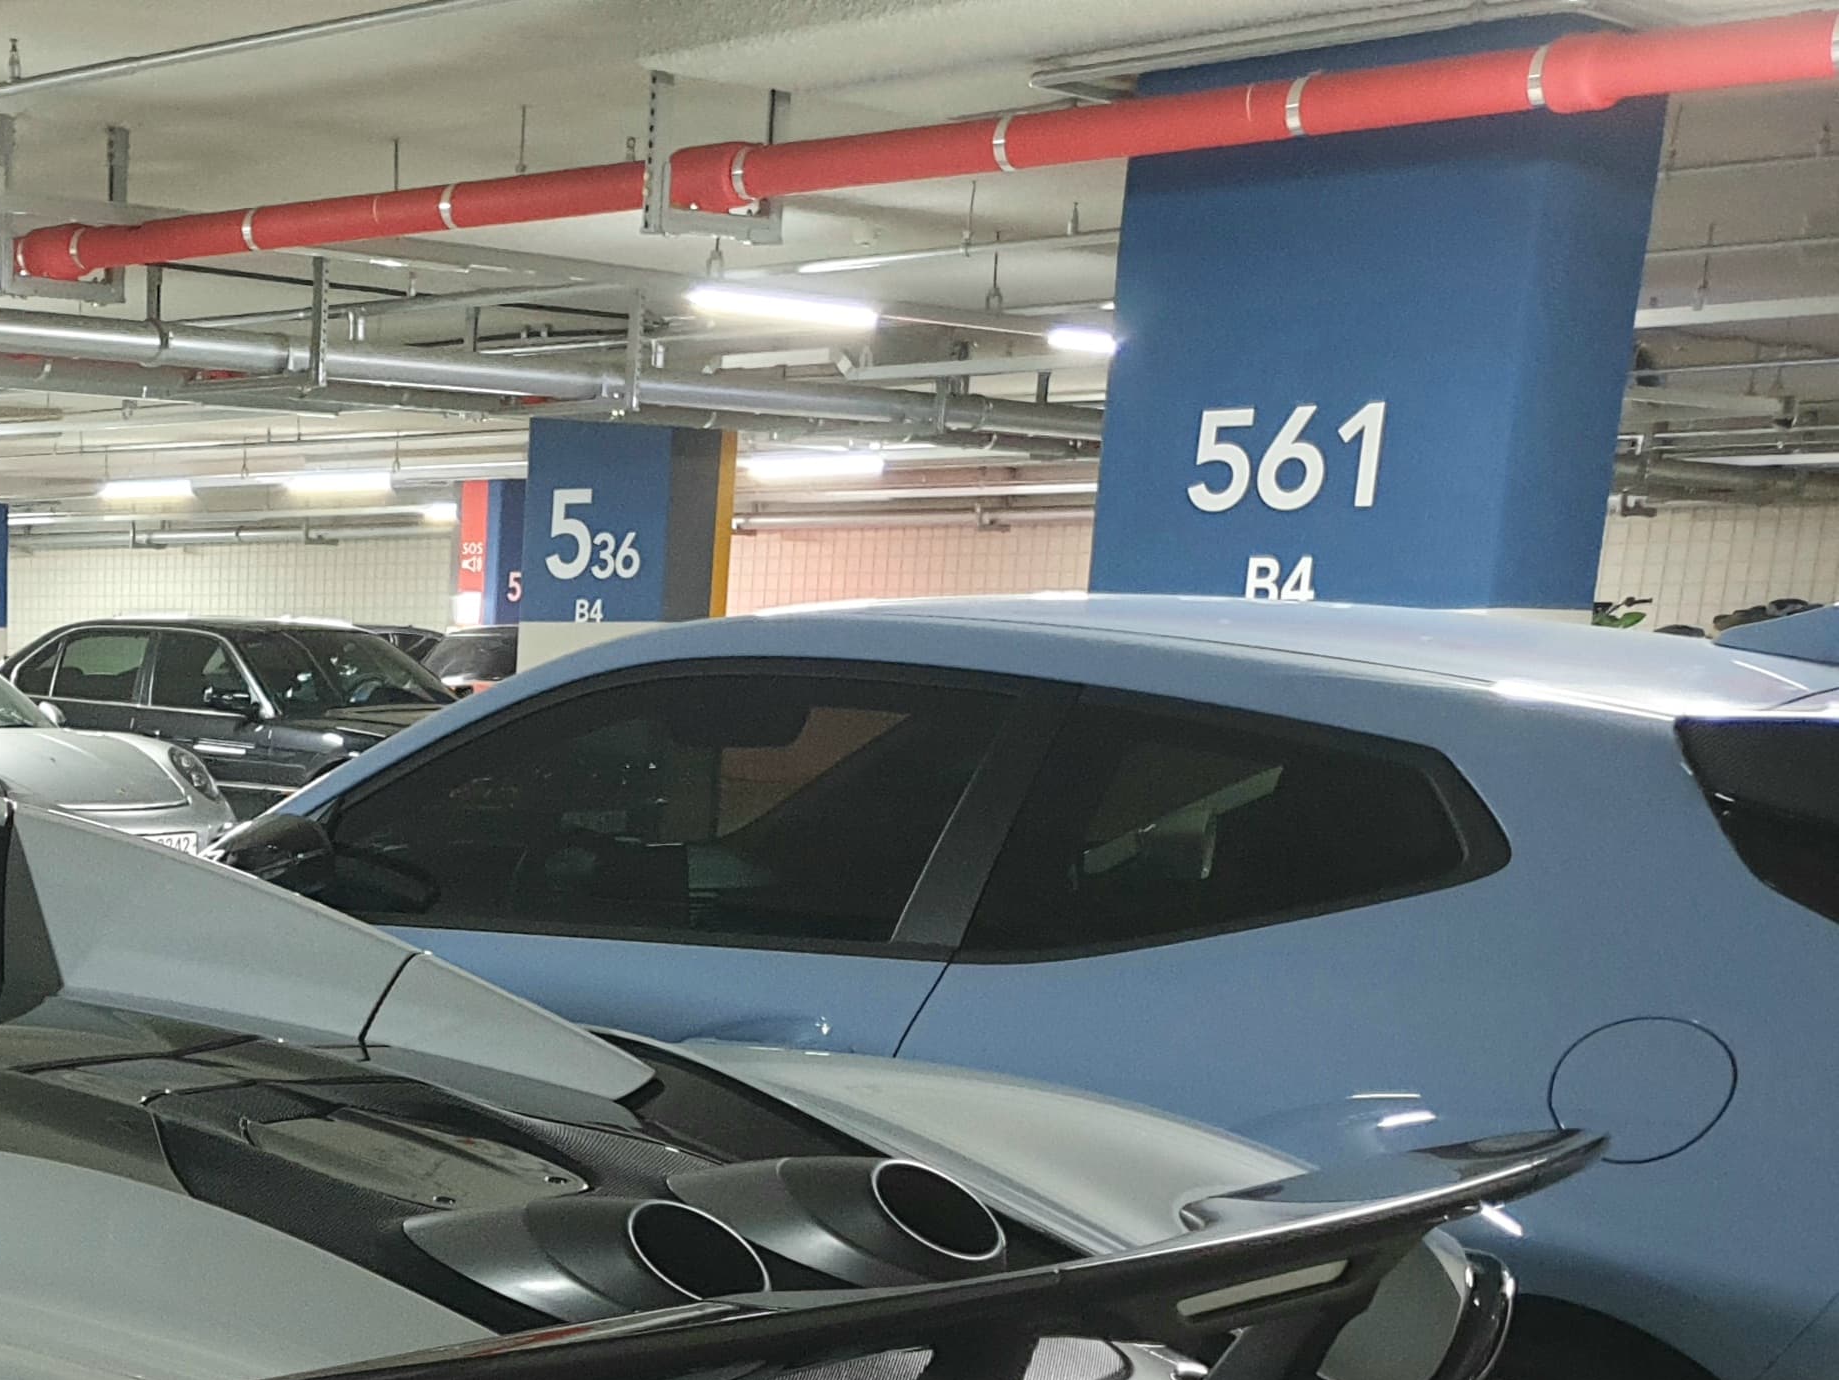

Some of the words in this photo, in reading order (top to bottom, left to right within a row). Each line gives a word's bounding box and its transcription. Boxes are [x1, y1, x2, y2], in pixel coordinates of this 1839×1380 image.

[1187, 401, 1386, 512] 561
[461, 541, 483, 555] SOS
[545, 488, 641, 580] 536
[1244, 555, 1315, 601] B4
[574, 598, 603, 623] B4
